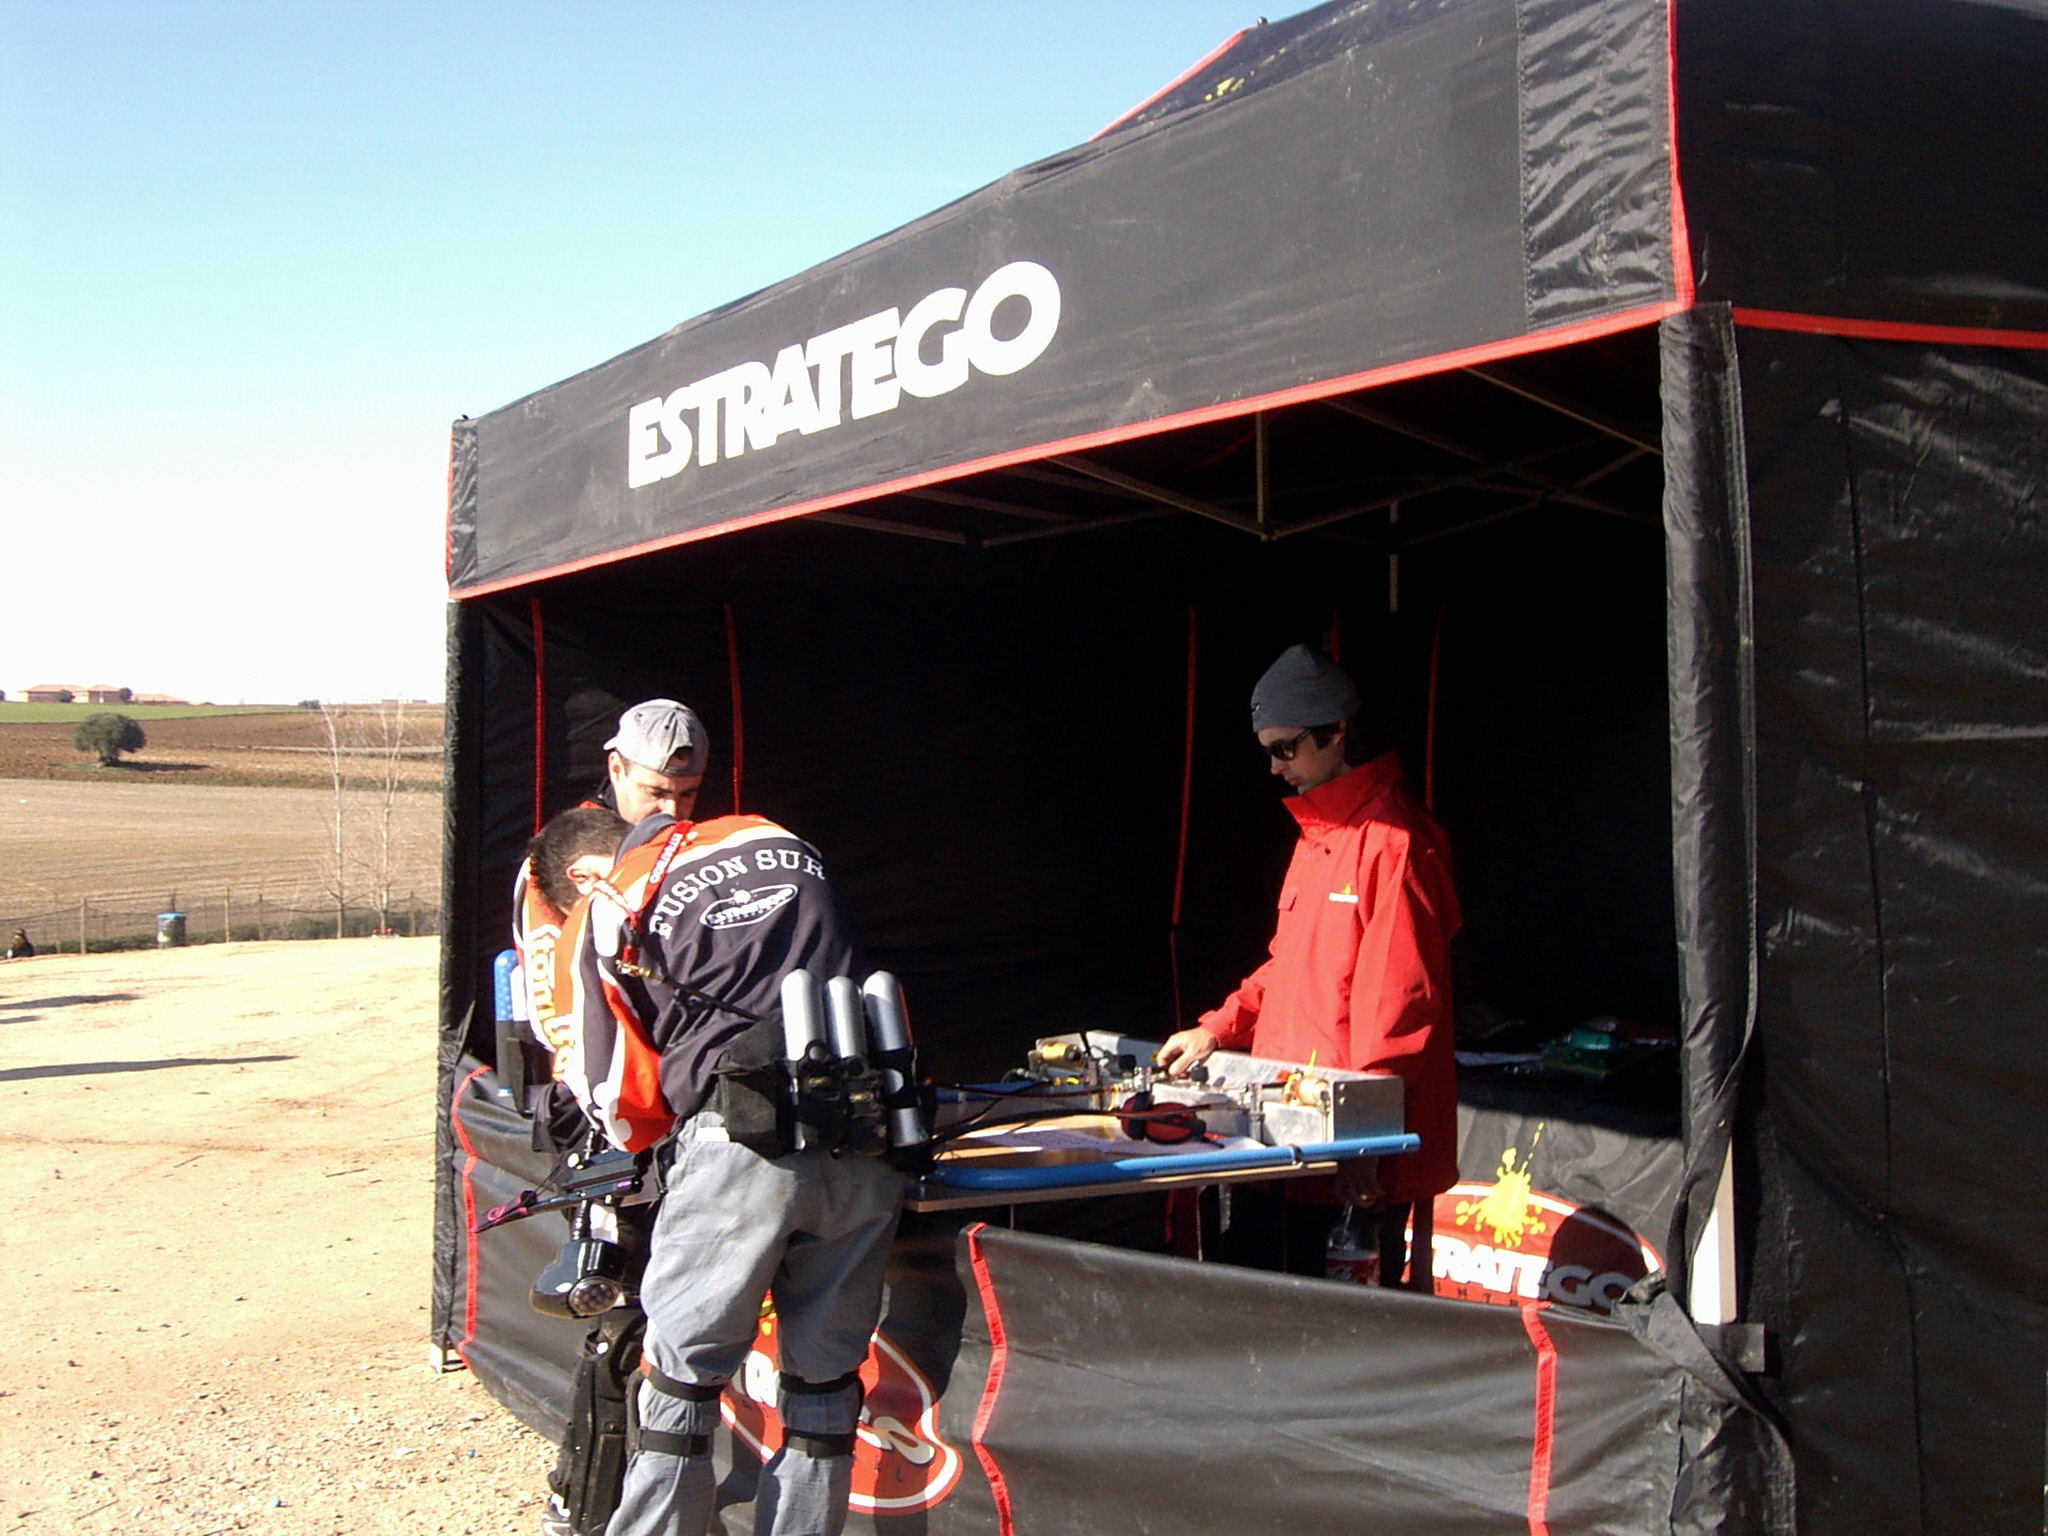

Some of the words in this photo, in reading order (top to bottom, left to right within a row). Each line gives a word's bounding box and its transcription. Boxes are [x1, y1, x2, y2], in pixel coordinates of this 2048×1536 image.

[629, 261, 1061, 489] ESTRATEGO
[649, 855, 749, 940] FUSION
[755, 849, 826, 881] SUR
[1432, 1233, 1636, 1311] RATEGO
